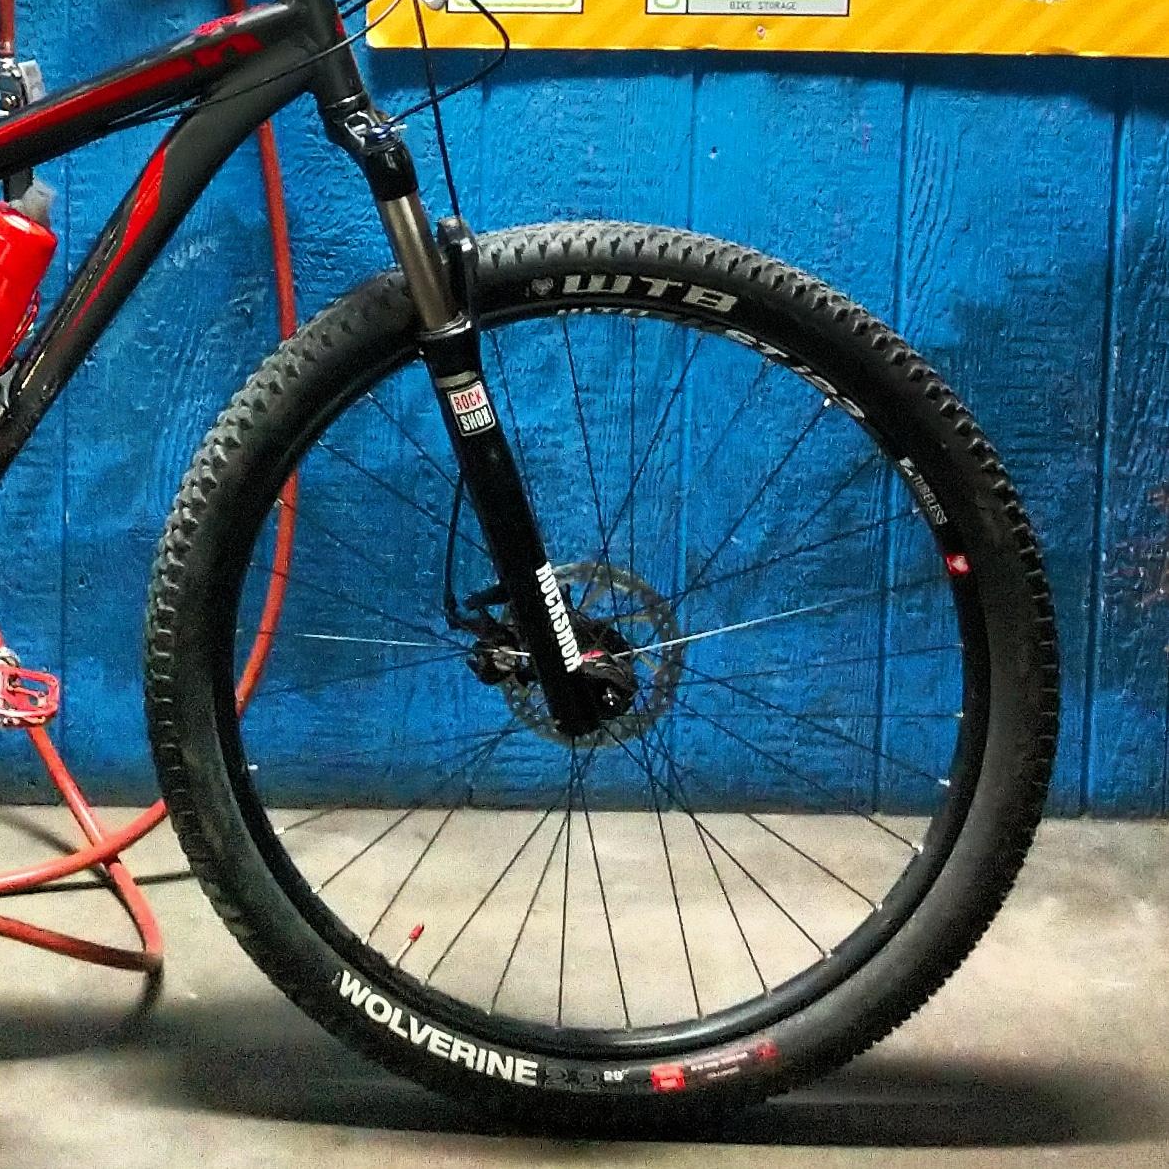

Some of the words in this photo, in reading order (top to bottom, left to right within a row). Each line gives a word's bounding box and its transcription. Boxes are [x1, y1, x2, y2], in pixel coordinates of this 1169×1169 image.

[729, 1, 753, 11] BIKE
[758, 1, 797, 11] STORAGE
[561, 273, 739, 313] WTB
[453, 390, 483, 411] ROCK
[536, 561, 584, 673] ROCKSHOX
[339, 969, 539, 1087] WOLVERINE
